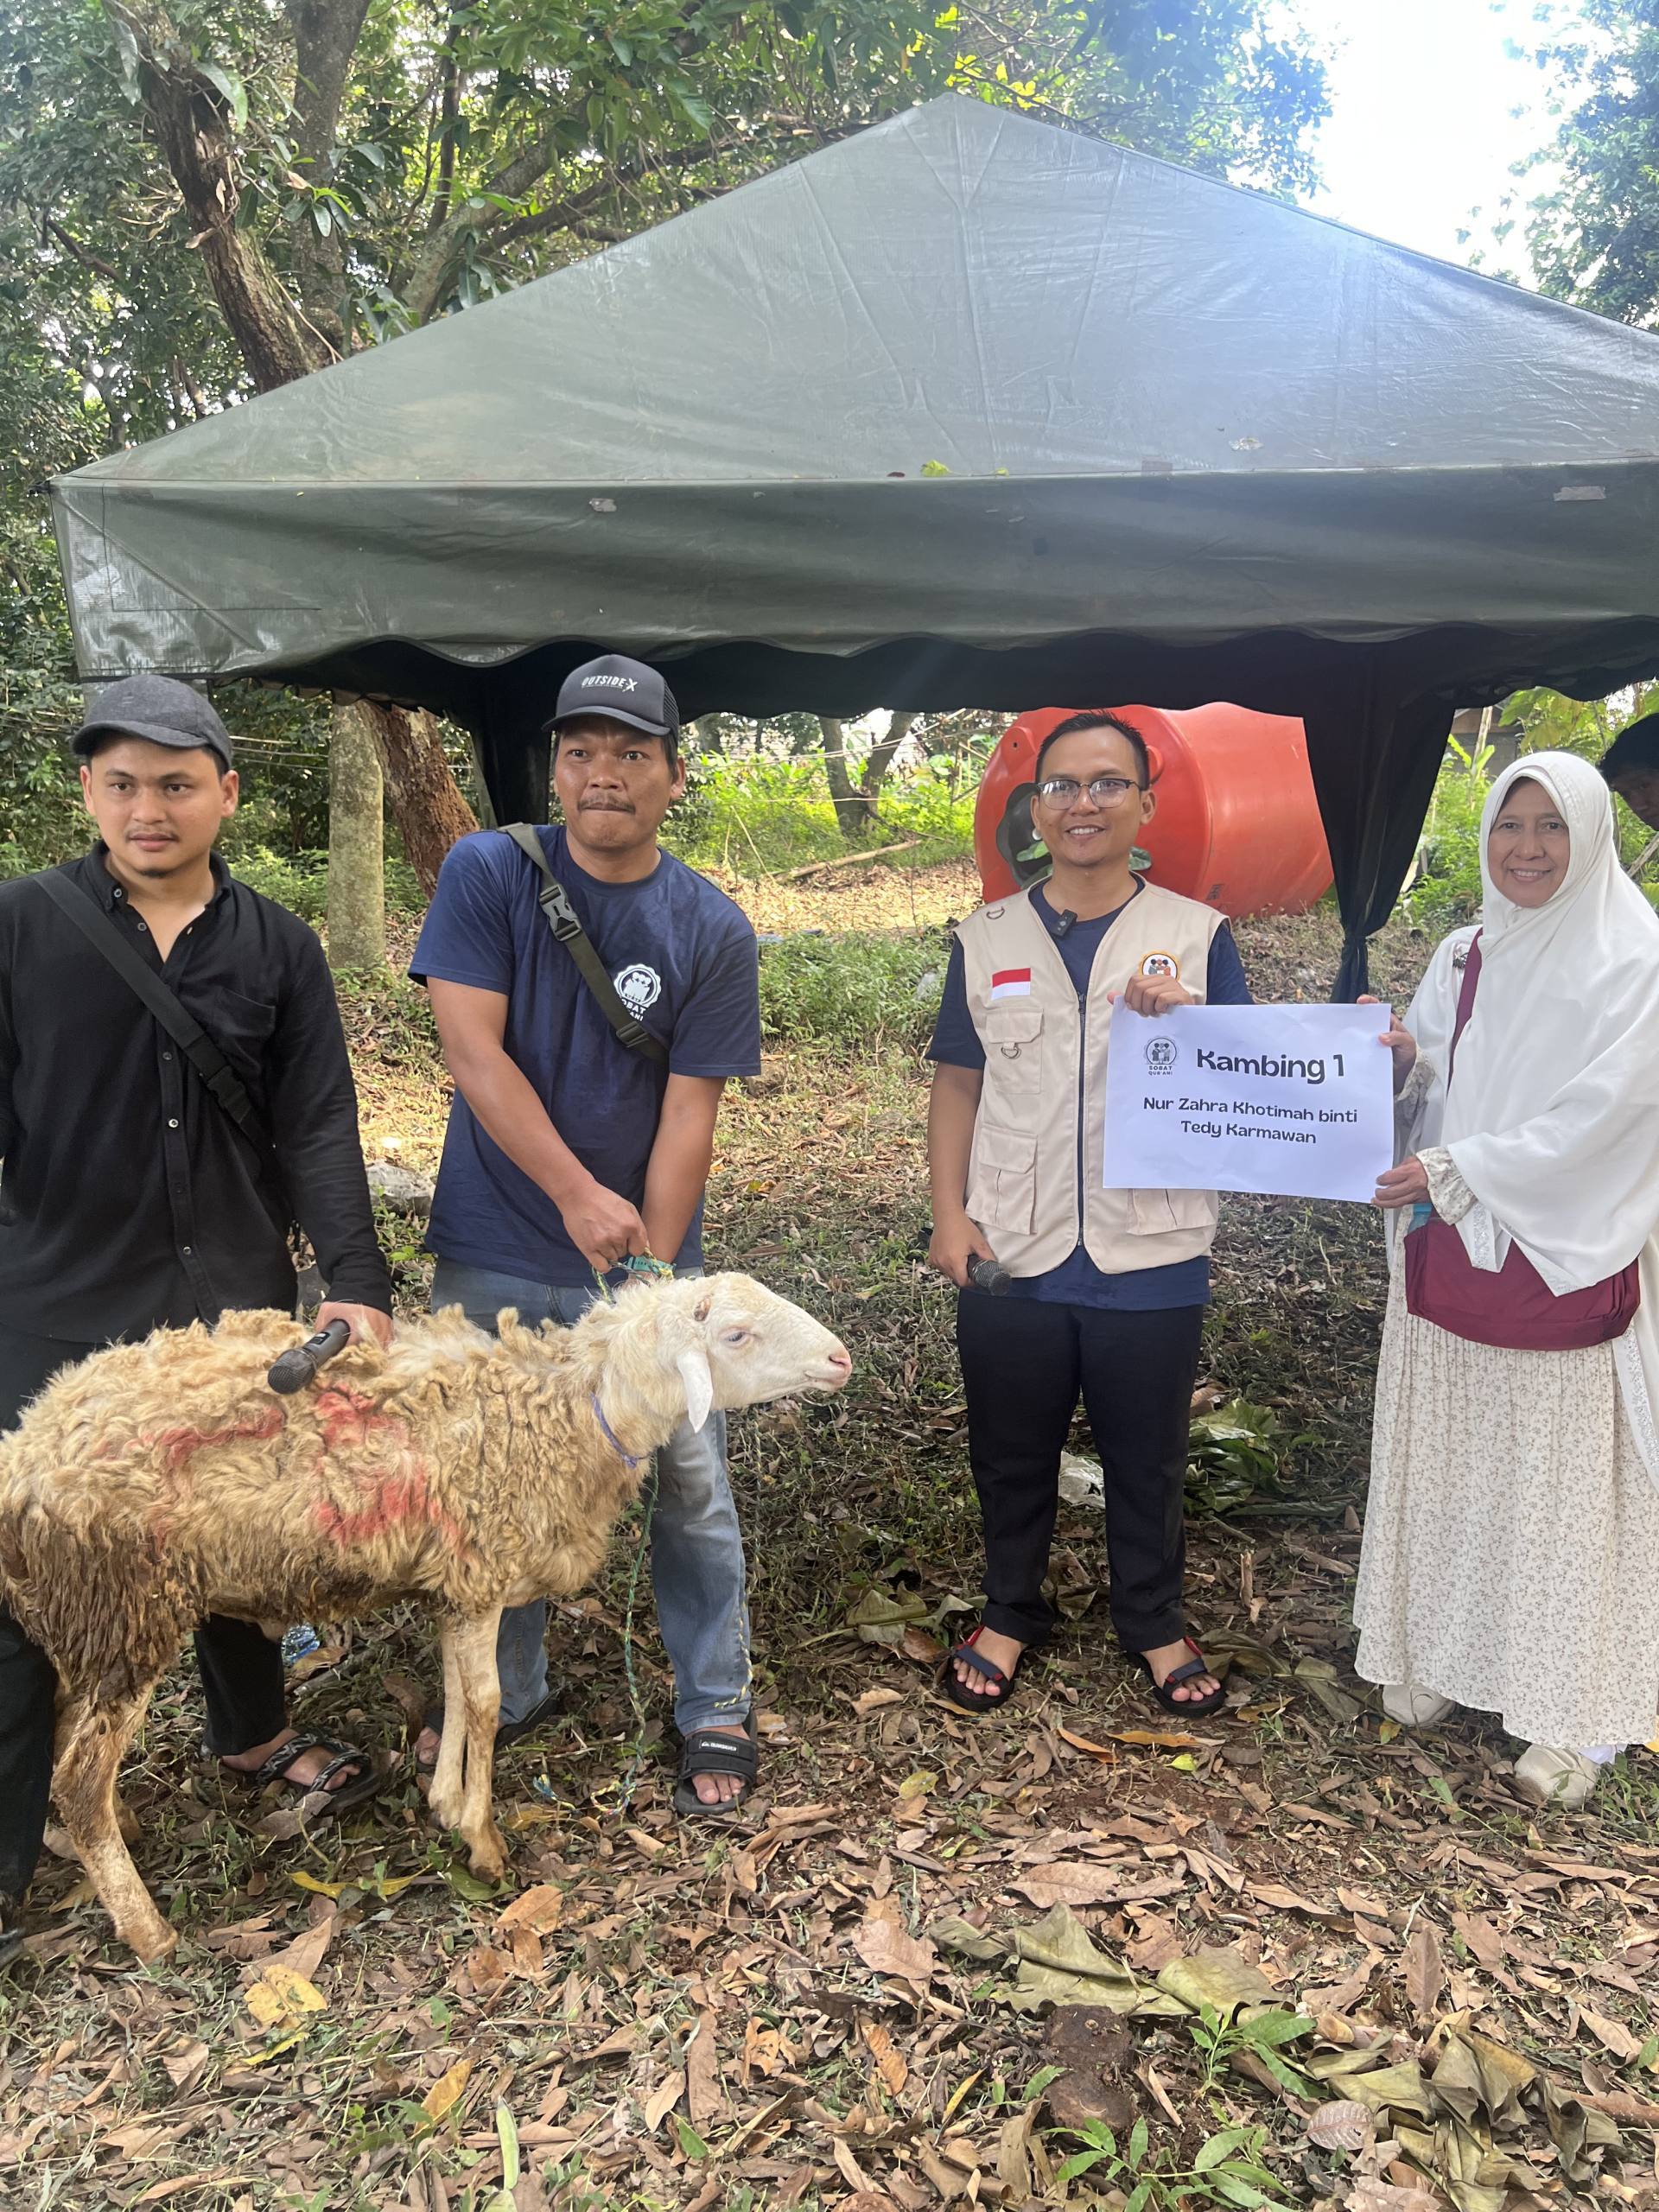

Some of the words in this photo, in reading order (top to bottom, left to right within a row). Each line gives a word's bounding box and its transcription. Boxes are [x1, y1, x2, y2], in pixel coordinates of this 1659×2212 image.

[621, 998, 646, 1014] OBAT
[1197, 1048, 1325, 1085] Kambing
[1332, 1053, 1344, 1077] 1
[1143, 1096, 1174, 1110] Nur
[1178, 1097, 1229, 1113] Zahra
[1232, 1101, 1314, 1122] Khotimah
[1319, 1109, 1357, 1123] binti
[1180, 1120, 1222, 1138] Tedy
[1226, 1122, 1317, 1144] Karmawan
